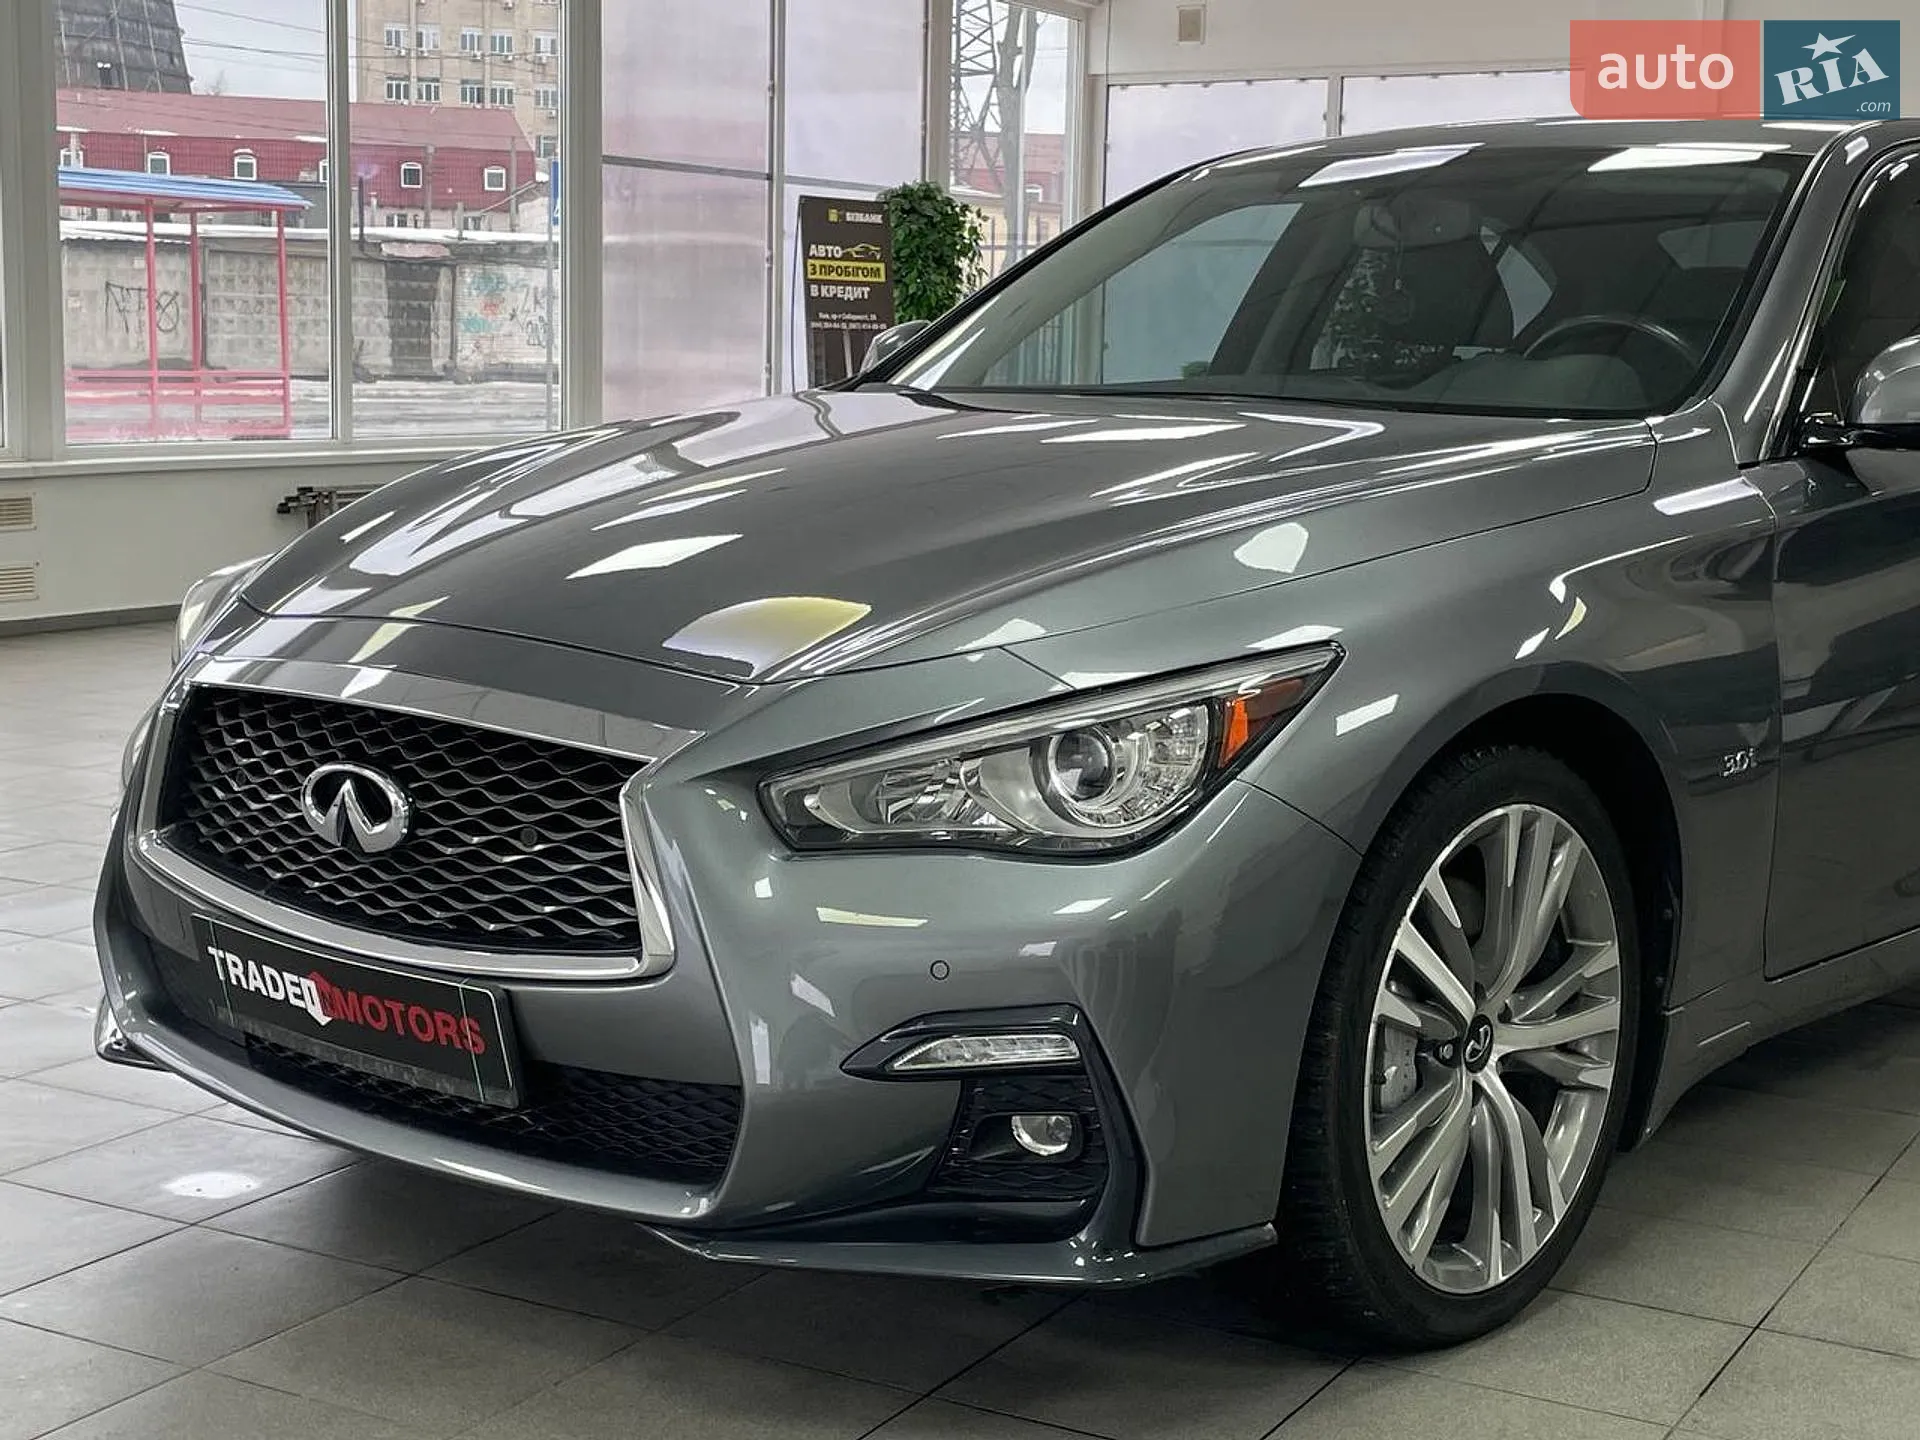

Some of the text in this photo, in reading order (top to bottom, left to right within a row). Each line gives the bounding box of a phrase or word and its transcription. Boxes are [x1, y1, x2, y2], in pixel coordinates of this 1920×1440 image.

[809, 244, 843, 258] АВТО
[819, 264, 881, 279] ПРОБІГОМ
[810, 284, 871, 301] В КРЕДИТ
[331, 987, 486, 1055] MOTORS
